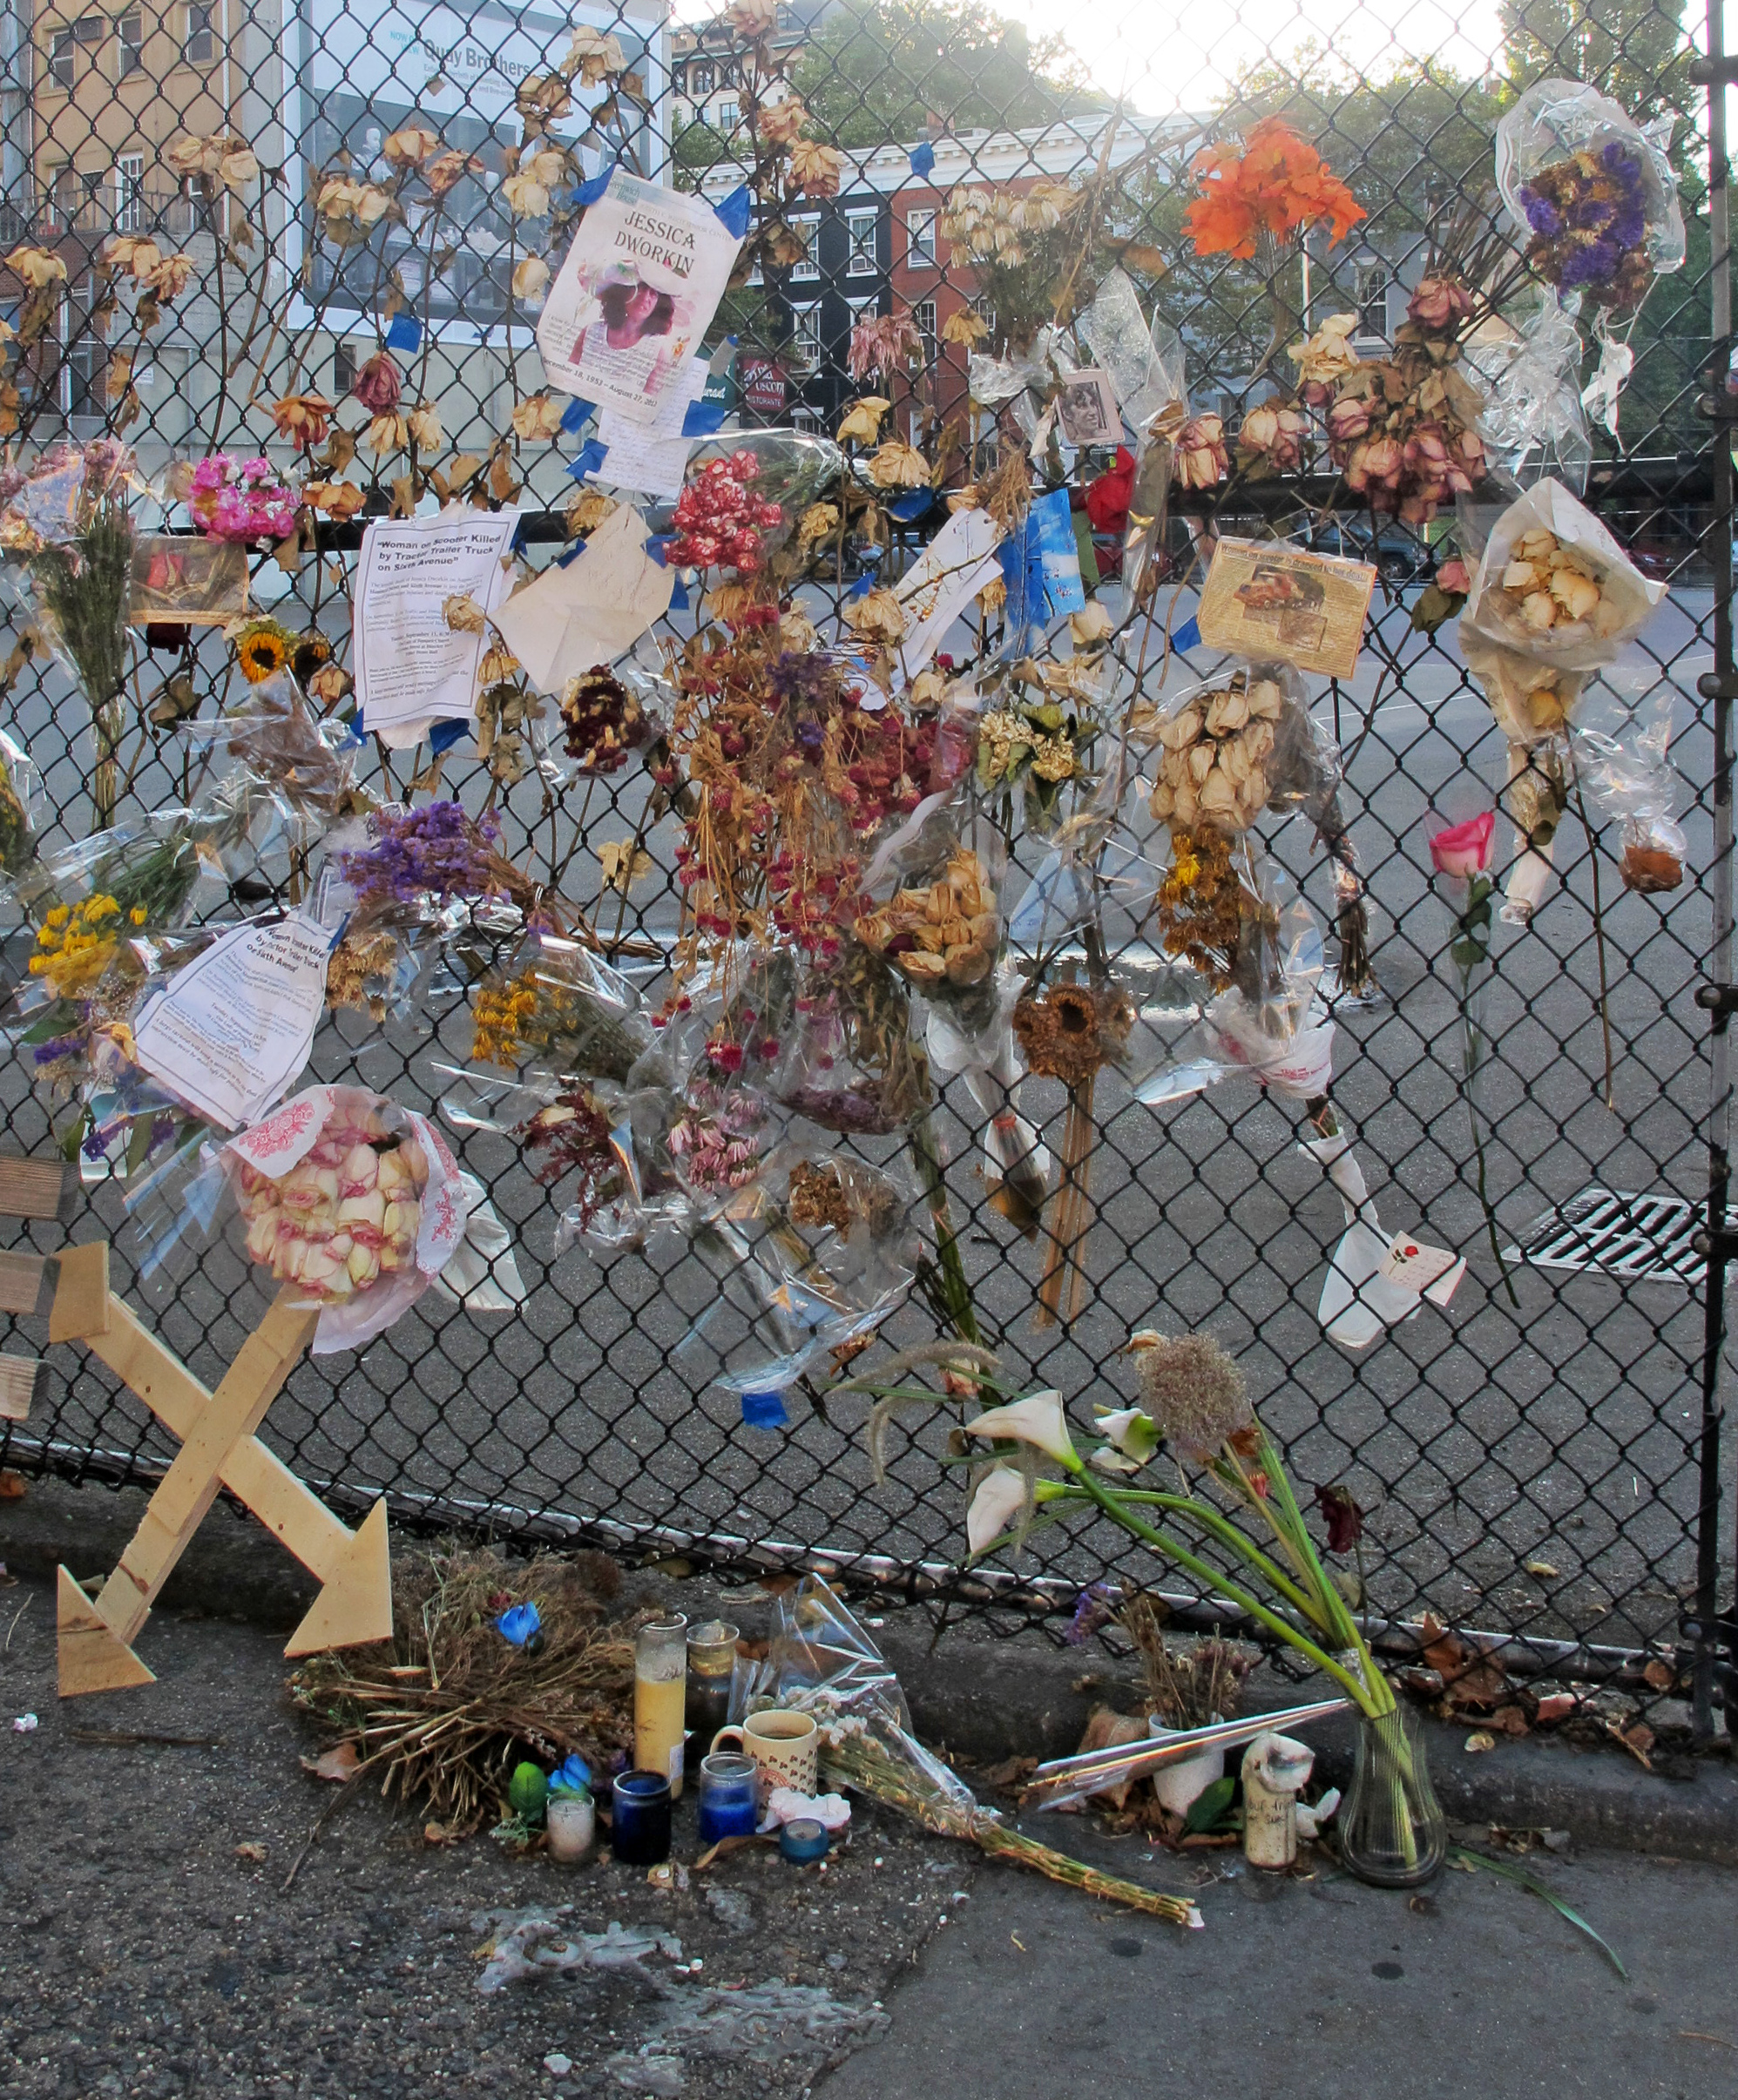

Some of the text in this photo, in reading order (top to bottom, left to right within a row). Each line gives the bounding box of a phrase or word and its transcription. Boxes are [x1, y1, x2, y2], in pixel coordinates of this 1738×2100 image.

[390, 30, 407, 42] NOW
[401, 43, 419, 54] VEW
[423, 38, 531, 77] Quay Brohers
[624, 211, 695, 250] JESSICA
[614, 231, 694, 273] DWORKIN
[574, 368, 584, 381] 18,
[585, 374, 604, 387] 1953
[609, 383, 632, 400] August
[632, 393, 643, 404] 27,
[471, 534, 501, 543] Killed
[379, 551, 391, 561] by
[430, 545, 462, 557] Trailer
[465, 546, 493, 556] Truck
[255, 933, 267, 947] by
